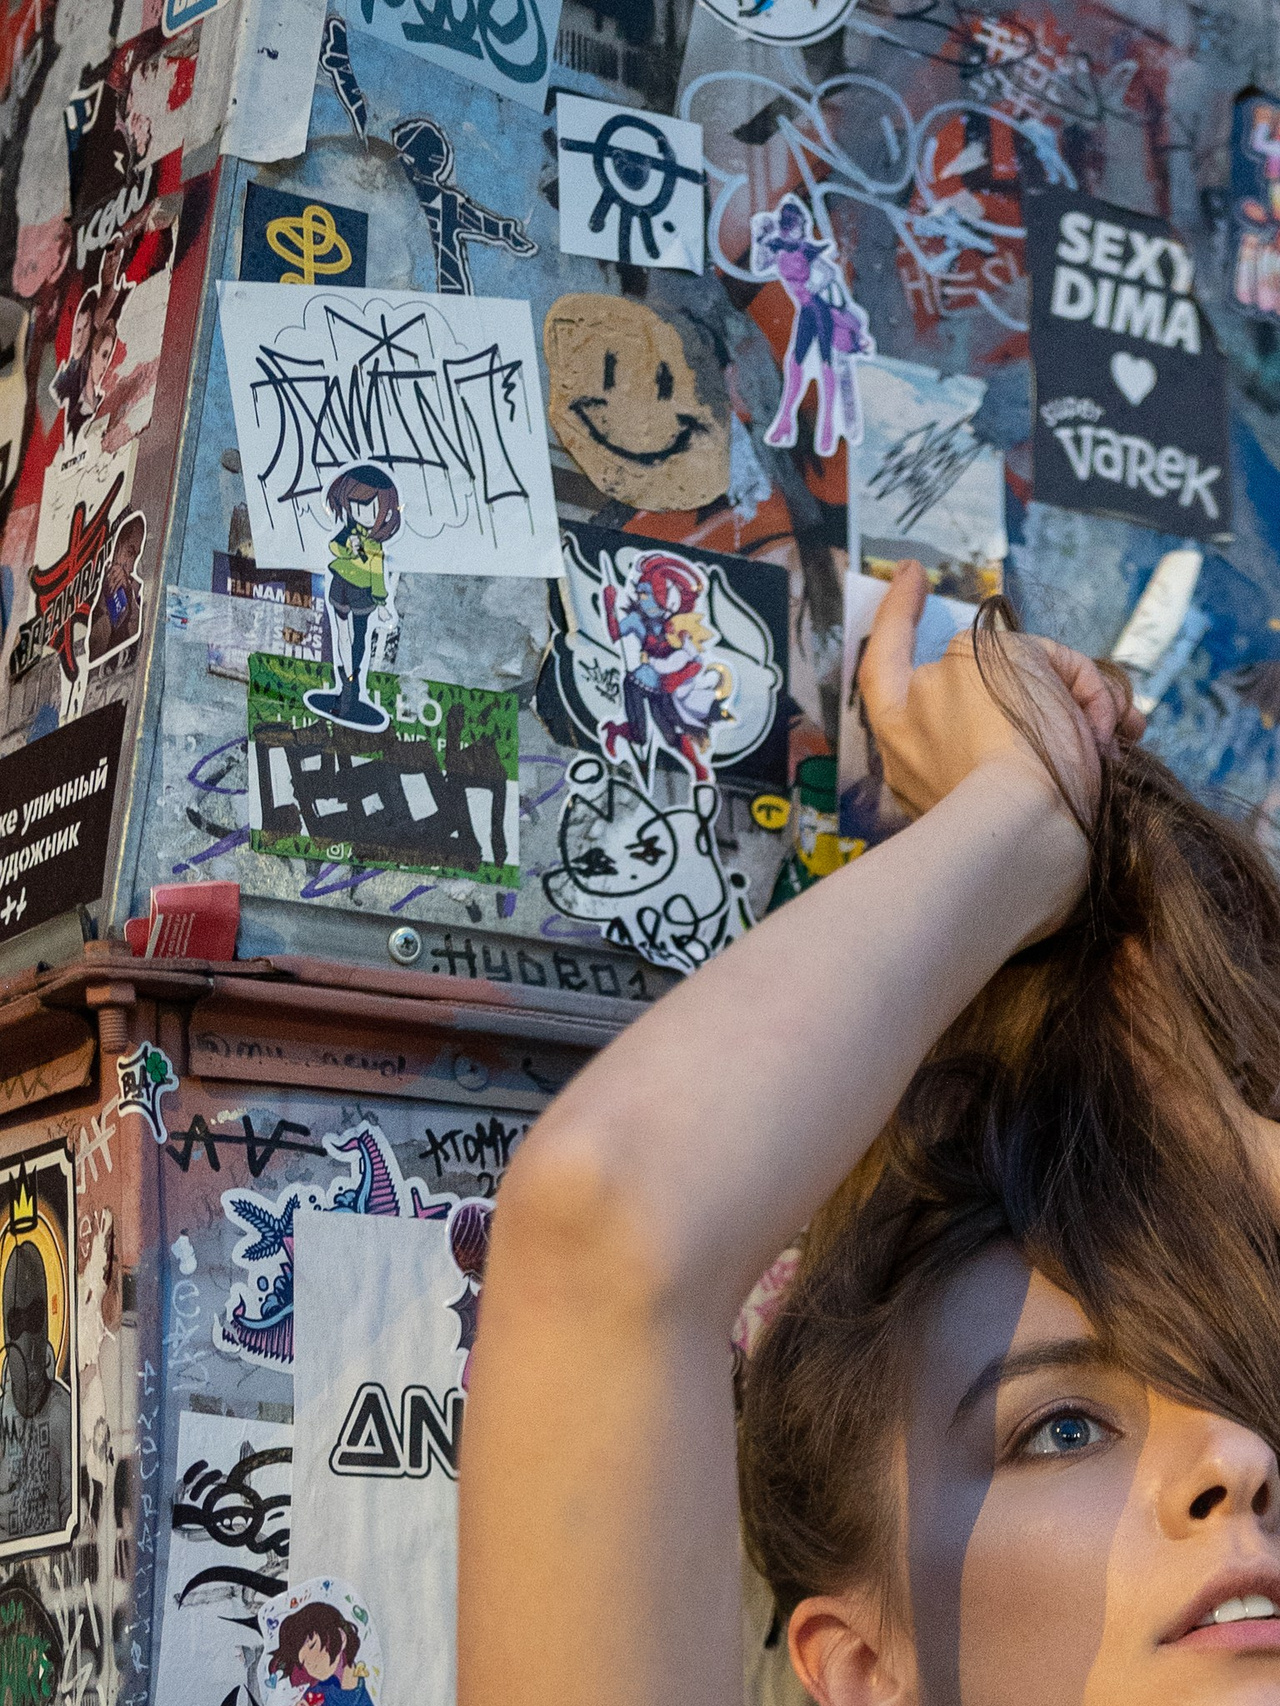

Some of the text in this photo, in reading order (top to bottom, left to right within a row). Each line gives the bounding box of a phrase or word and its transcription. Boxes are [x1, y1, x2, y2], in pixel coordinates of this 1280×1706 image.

[1056, 211, 1195, 293] SEXY
[1050, 264, 1202, 356] DIMA
[21, 756, 108, 837] уличный
